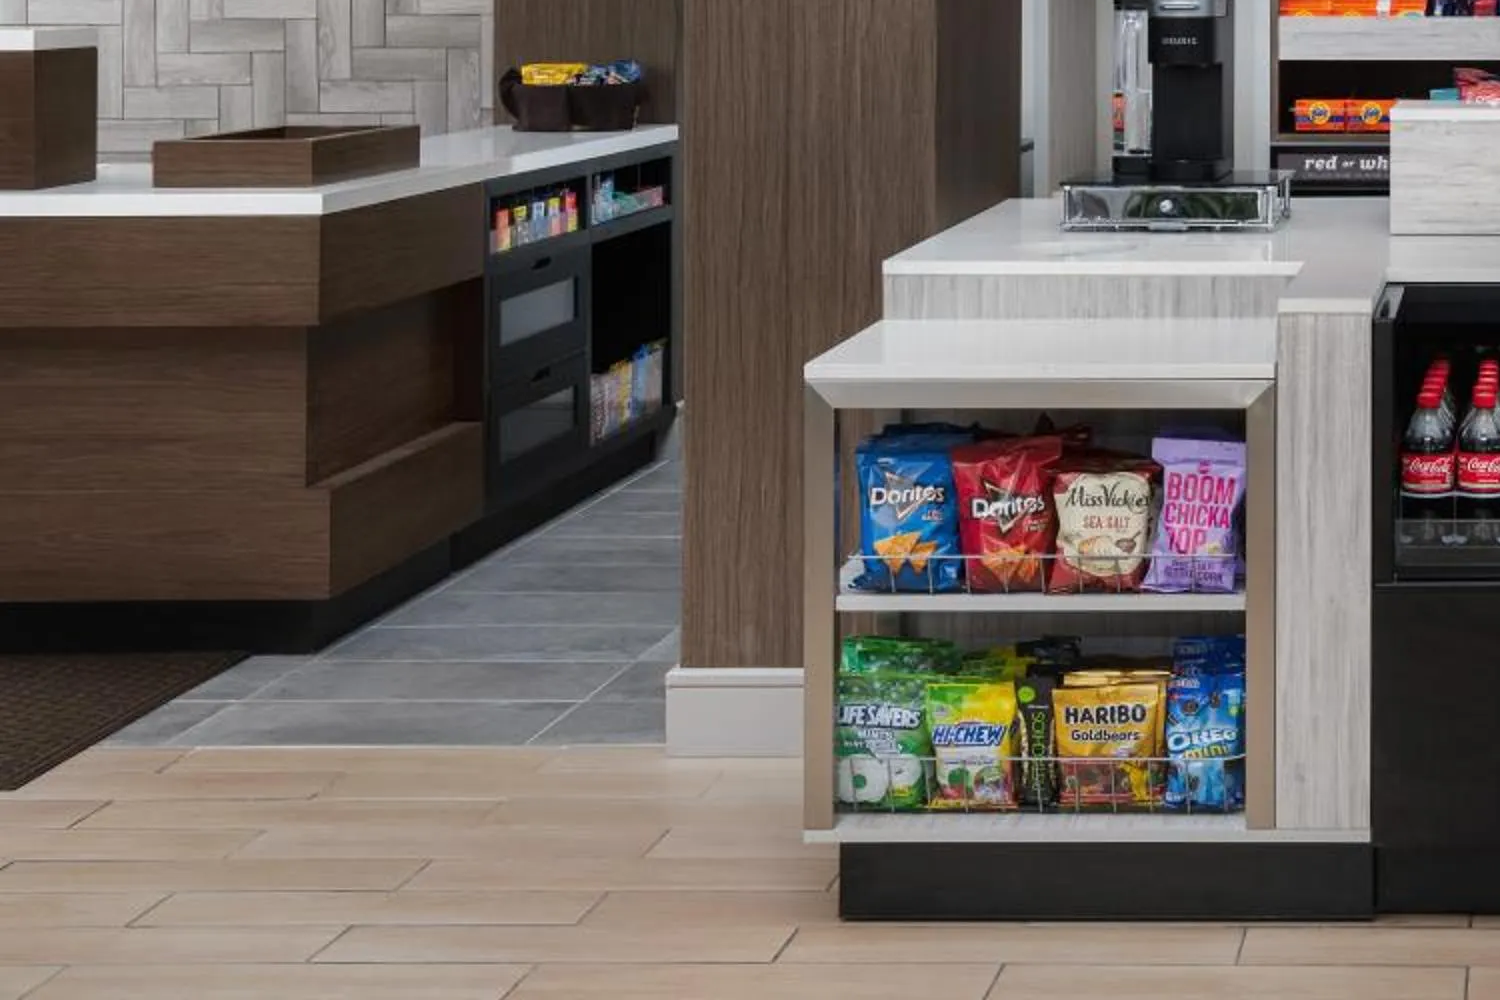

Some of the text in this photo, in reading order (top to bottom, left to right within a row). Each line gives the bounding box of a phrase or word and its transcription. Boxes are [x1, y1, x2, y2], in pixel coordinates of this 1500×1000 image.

[1304, 155, 1338, 171] red
[1359, 155, 1388, 170] wh
[871, 485, 945, 506] Doritos
[1065, 485, 1103, 508] Miss
[1166, 471, 1237, 505] BOOM
[971, 495, 1046, 518] Doritos
[1164, 502, 1230, 529] CHICKA
[1083, 515, 1130, 529] SEA SALT
[1064, 704, 1147, 725] HARIBO
[932, 723, 1006, 746] HI-CHEW
[1071, 730, 1141, 742] Goldbears
[1168, 728, 1238, 752] OREO
